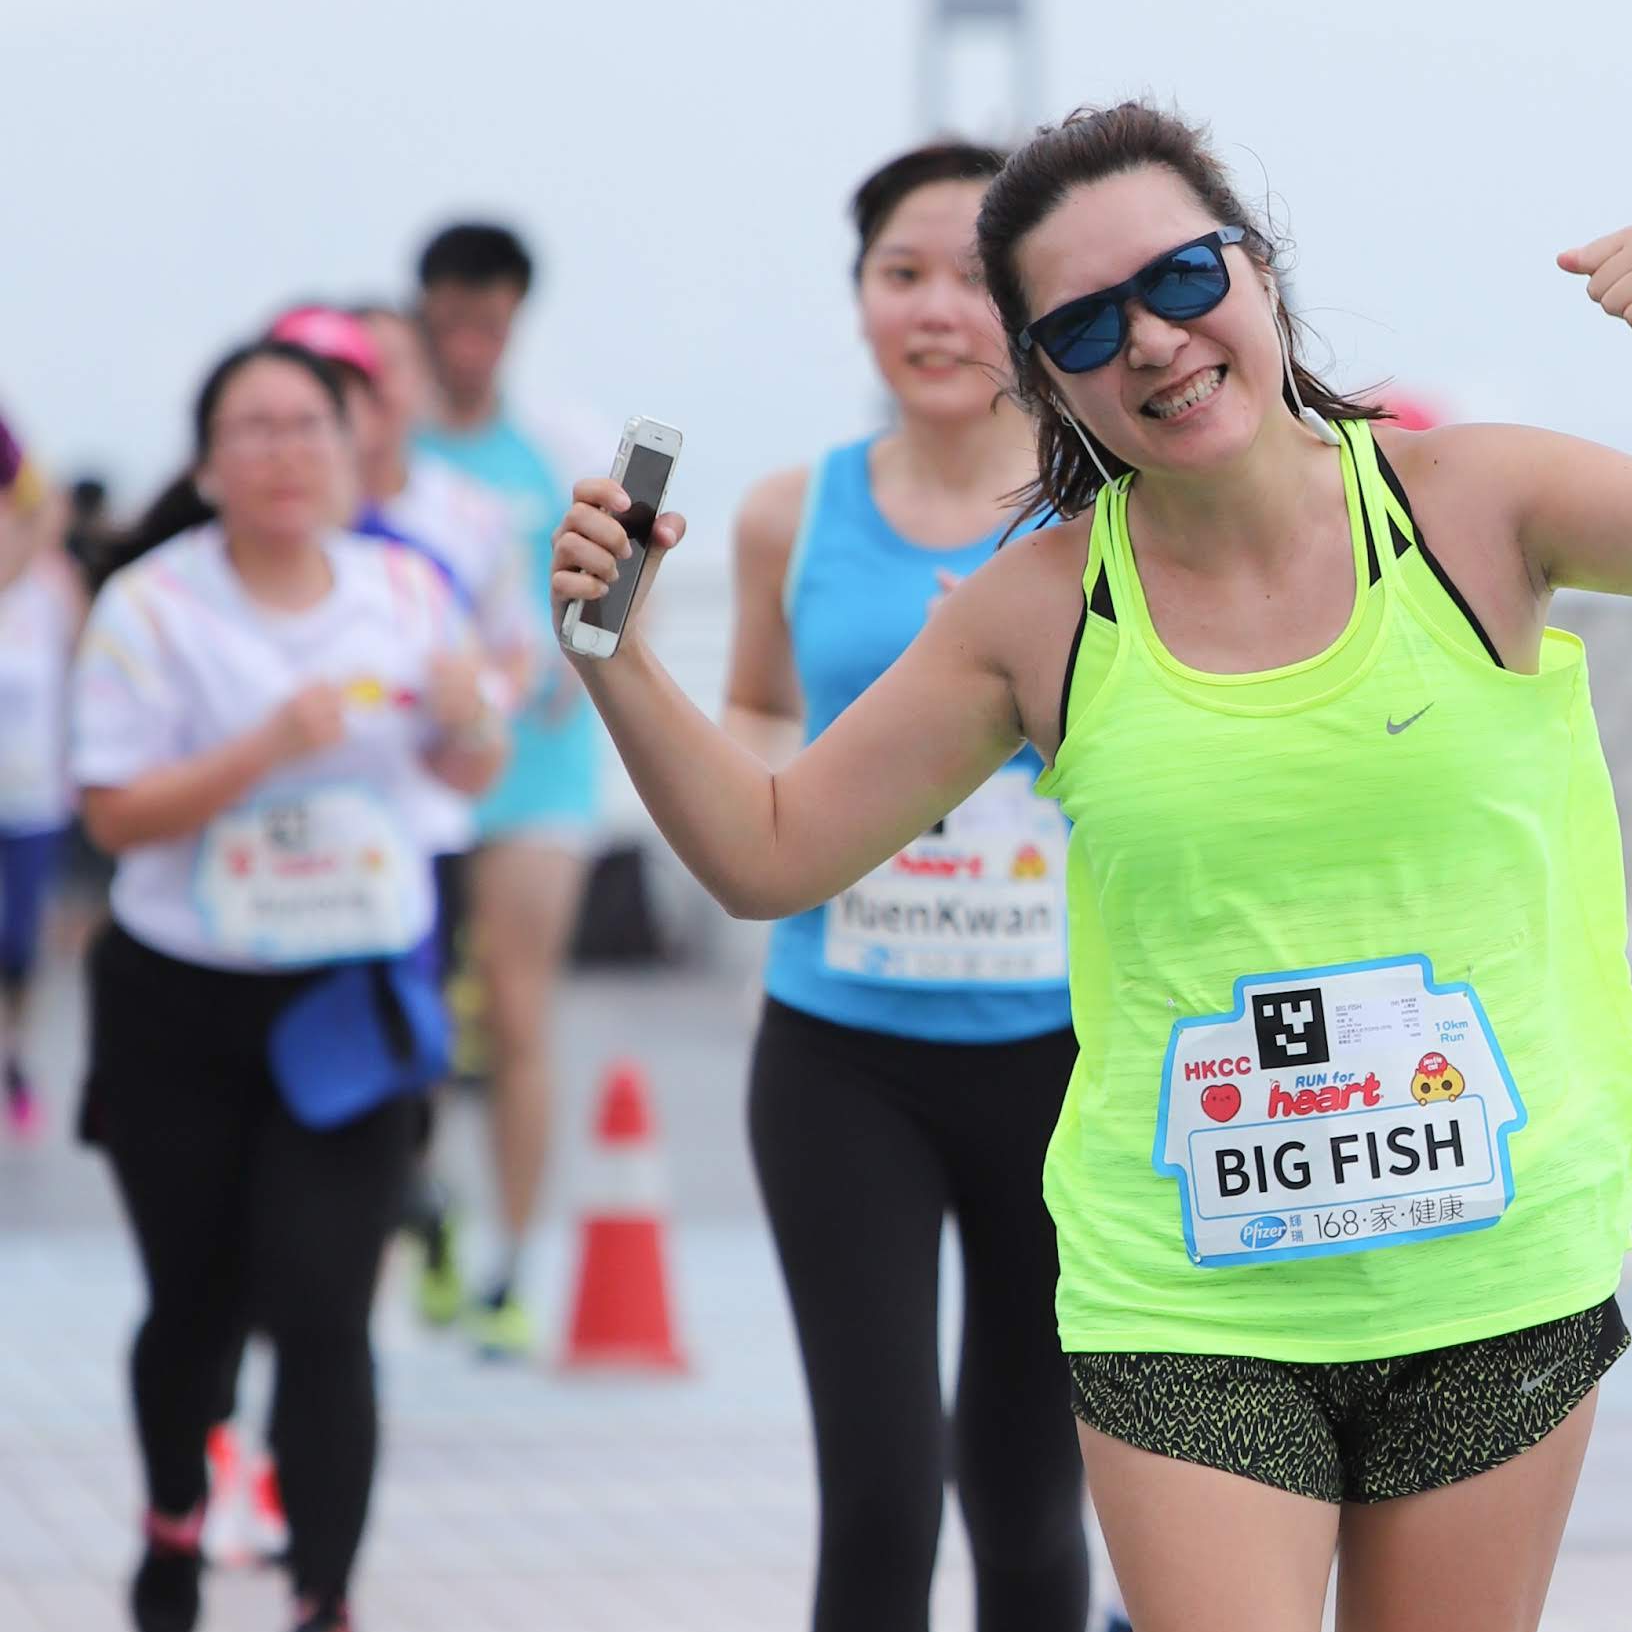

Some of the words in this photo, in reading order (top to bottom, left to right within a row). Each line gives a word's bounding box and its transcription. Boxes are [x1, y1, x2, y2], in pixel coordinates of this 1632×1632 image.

[1434, 1020, 1469, 1032] 10km
[1440, 1032, 1465, 1044] Run
[1184, 1056, 1252, 1081] HKCC
[1295, 1075, 1327, 1089] RUN
[1331, 1070, 1355, 1084] for
[1267, 1071, 1381, 1119] heart
[1215, 1141, 1311, 1198] BIG
[1330, 1119, 1465, 1185] FISH
[1242, 1221, 1287, 1249] Pfizer
